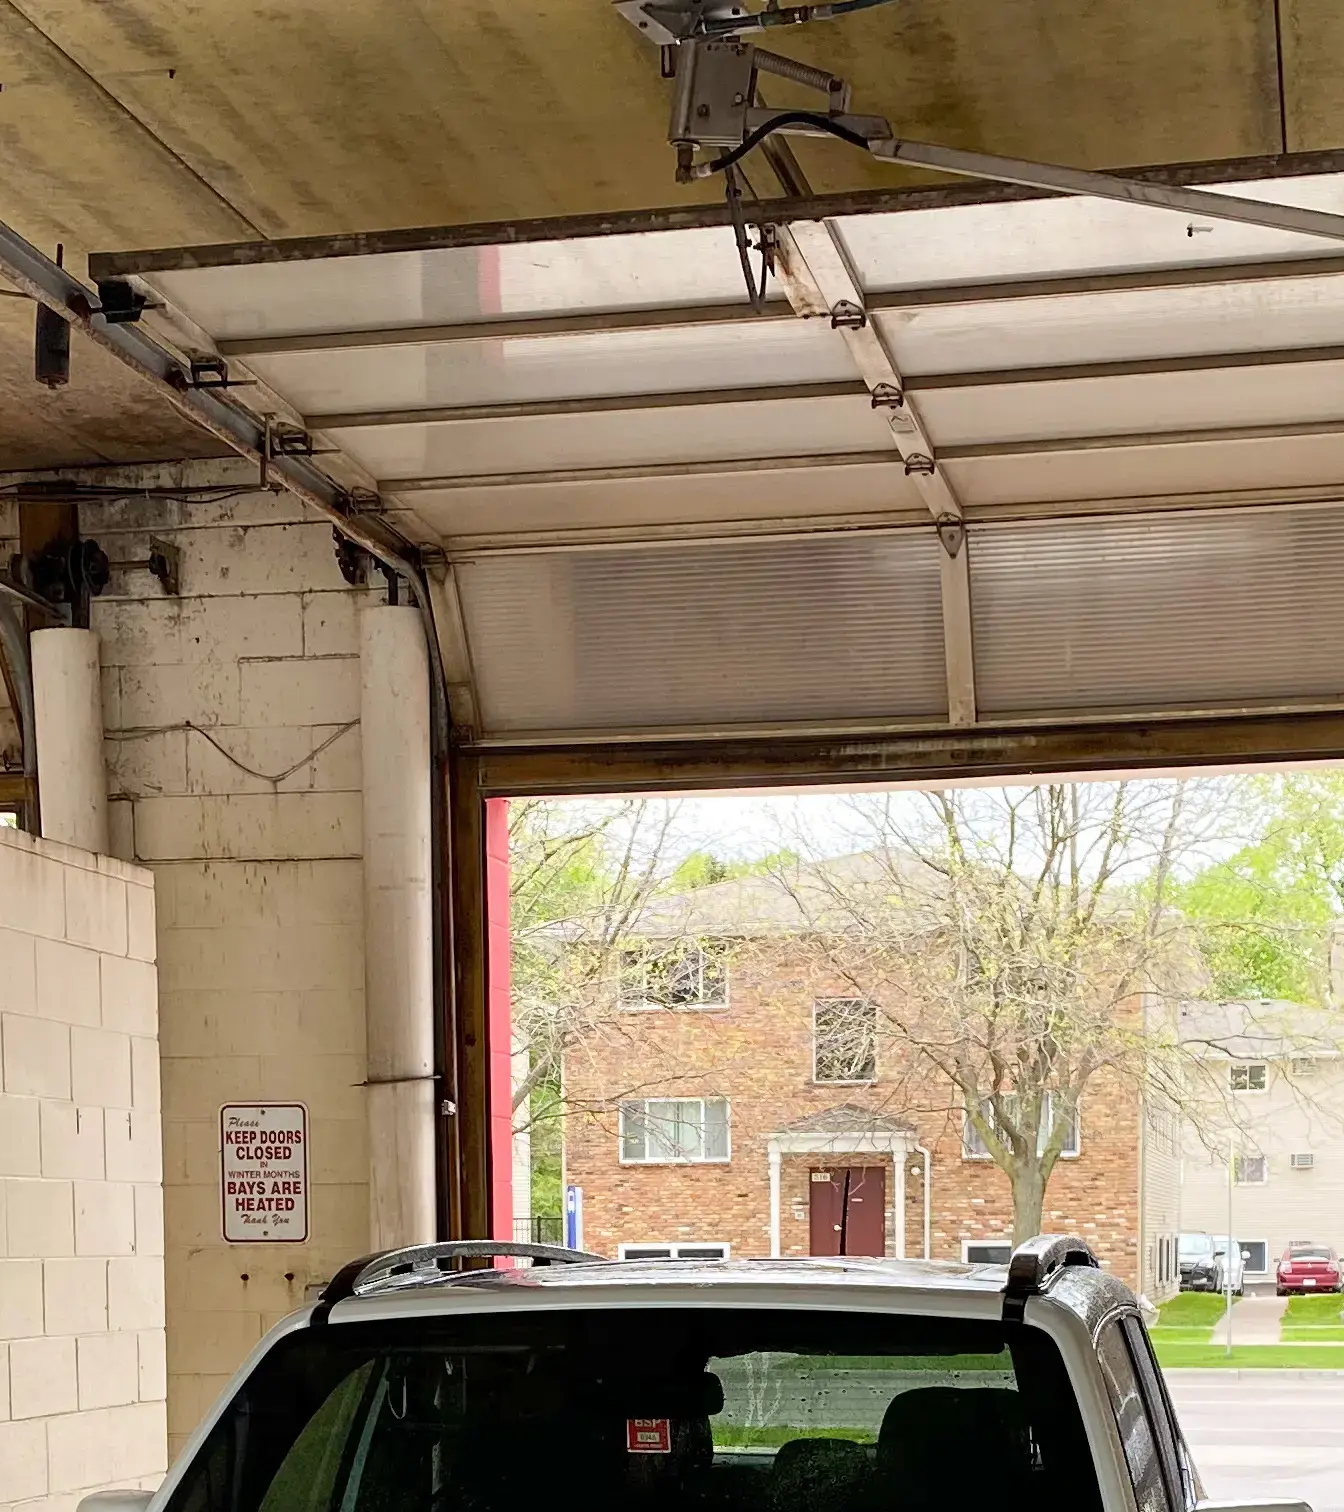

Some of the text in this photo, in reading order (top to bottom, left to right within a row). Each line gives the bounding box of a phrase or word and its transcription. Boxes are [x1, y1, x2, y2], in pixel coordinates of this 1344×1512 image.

[228, 1116, 260, 1128] Please
[226, 1130, 302, 1144] KEEP DOORS
[236, 1146, 292, 1160] CLOSED
[228, 1170, 300, 1178] WINTER MONTHS
[228, 1182, 302, 1195] BAYS ARE
[236, 1198, 295, 1212] HEATED
[240, 1214, 290, 1226] Thank You
